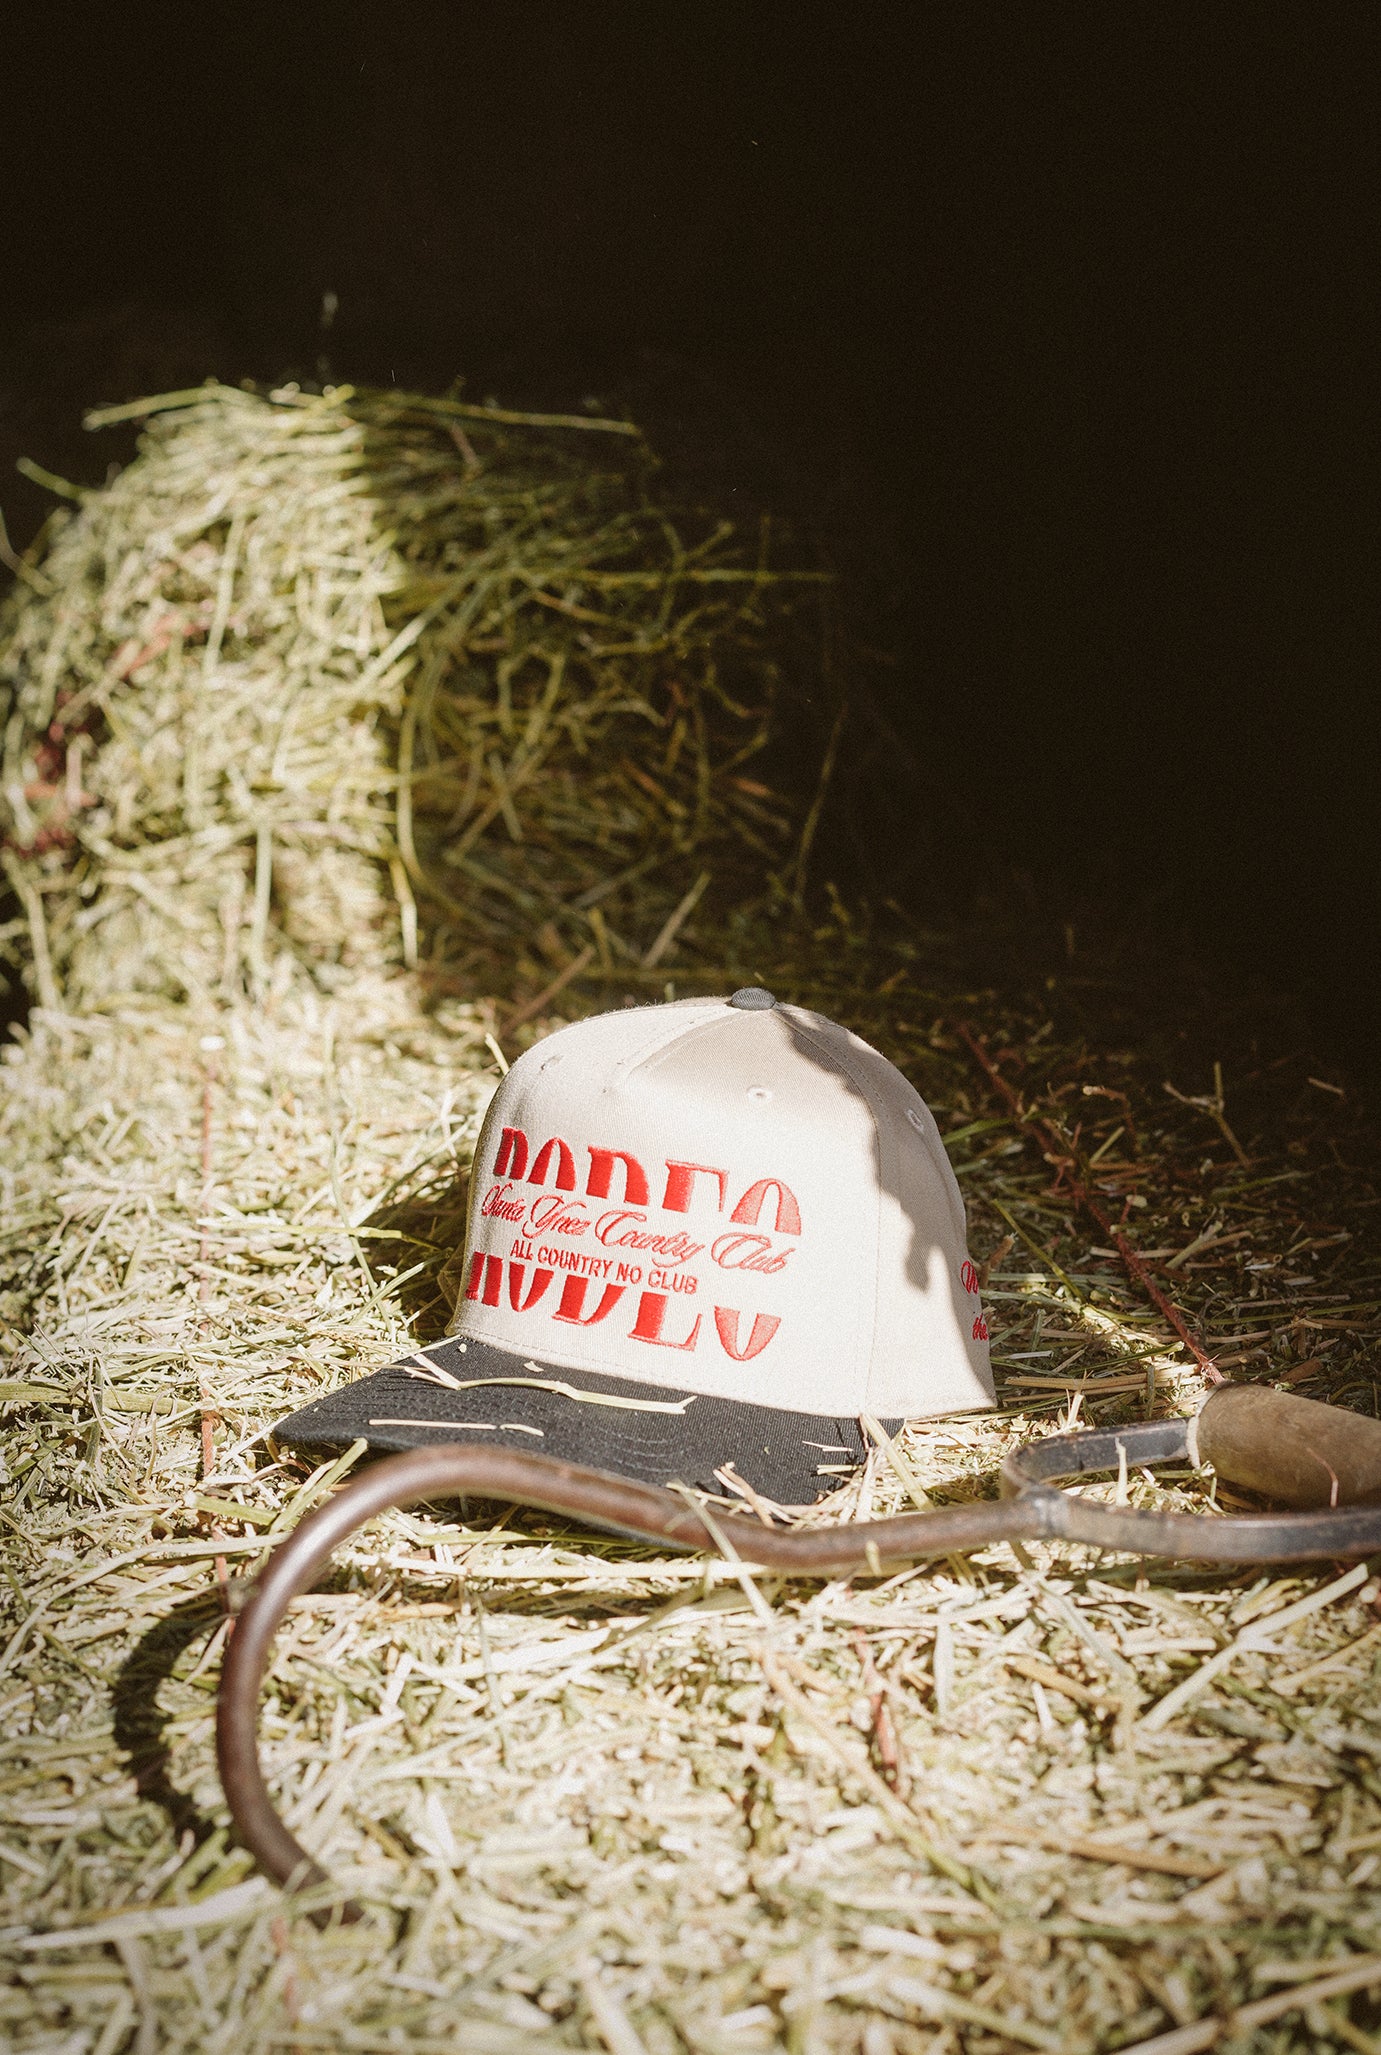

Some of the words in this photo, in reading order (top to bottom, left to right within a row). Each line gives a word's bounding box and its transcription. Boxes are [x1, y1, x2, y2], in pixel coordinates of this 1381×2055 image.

[481, 1182, 525, 1223] Santa
[522, 1194, 591, 1239] Ynez
[595, 1209, 706, 1268] Country
[711, 1231, 796, 1275] Club
[510, 1239, 534, 1261] ALL
[538, 1245, 613, 1278] COUNTRY
[616, 1262, 643, 1285] NO
[648, 1269, 698, 1295] CLUB
